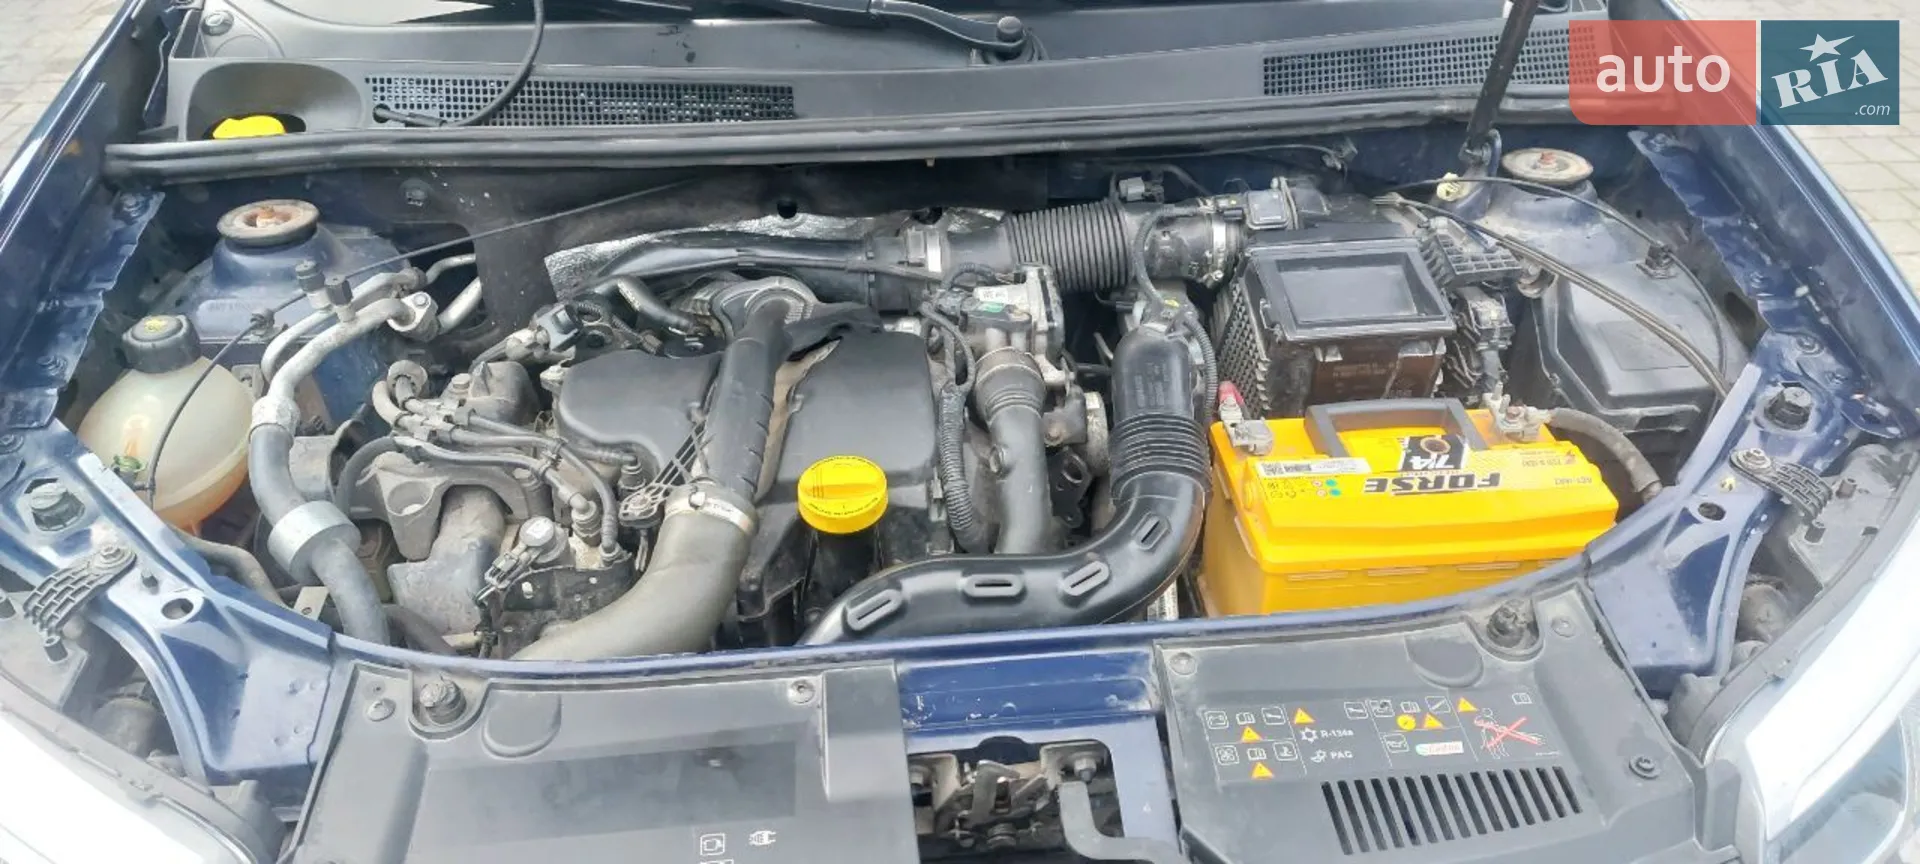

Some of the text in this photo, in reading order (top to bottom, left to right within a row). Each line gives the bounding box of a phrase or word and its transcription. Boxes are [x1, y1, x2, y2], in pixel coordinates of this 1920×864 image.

[1363, 472, 1501, 493] FORSE
[1320, 729, 1354, 738] R-134a
[1330, 750, 1353, 760] PAG
